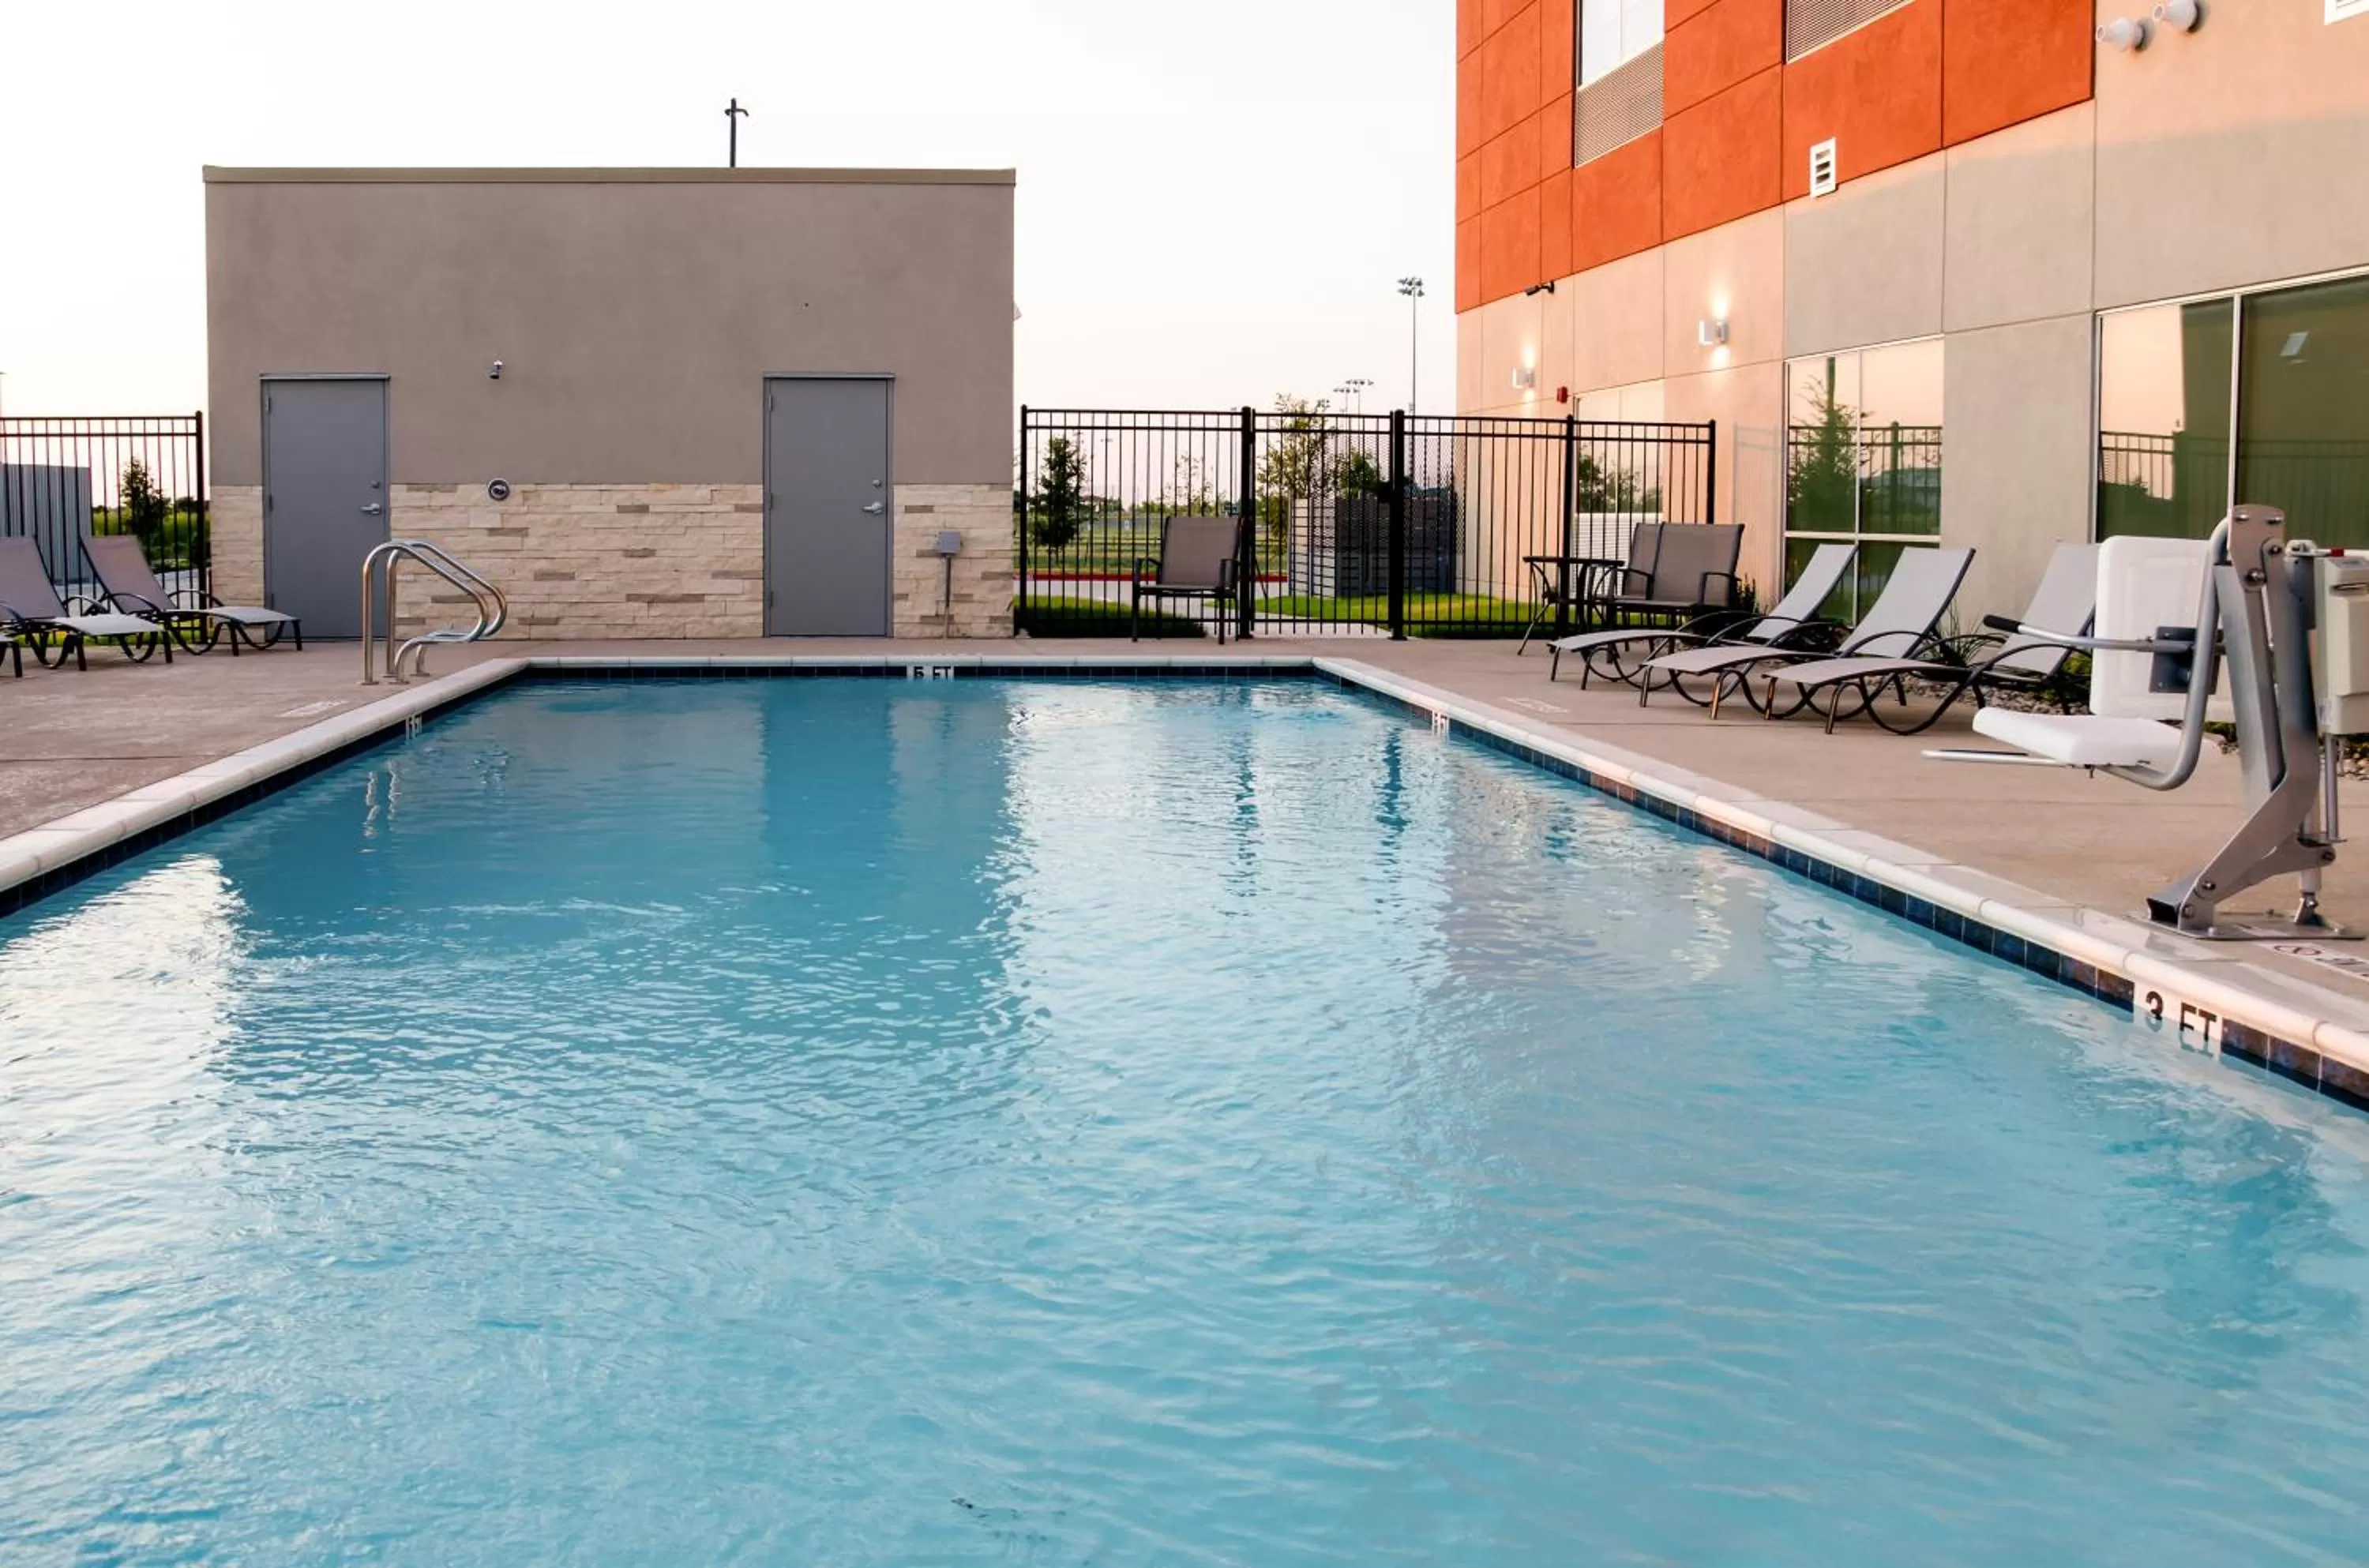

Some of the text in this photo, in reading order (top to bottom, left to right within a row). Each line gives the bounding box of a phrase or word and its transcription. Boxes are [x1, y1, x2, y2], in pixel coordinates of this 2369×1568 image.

[933, 666, 952, 678] FT
[2146, 990, 2217, 1042] 3 FT
